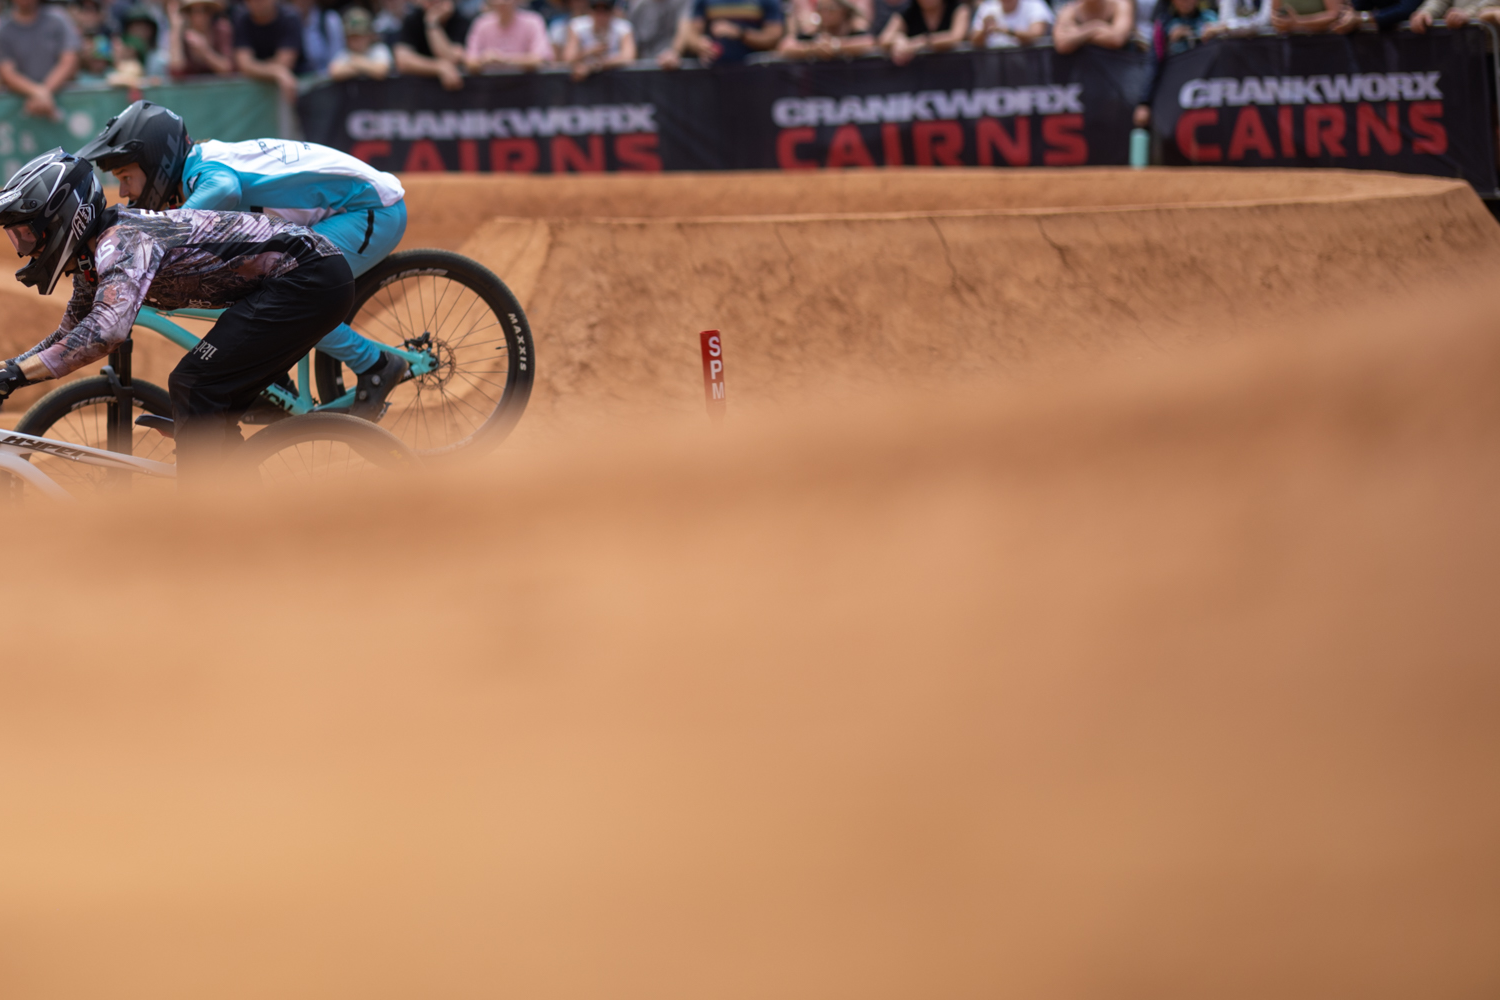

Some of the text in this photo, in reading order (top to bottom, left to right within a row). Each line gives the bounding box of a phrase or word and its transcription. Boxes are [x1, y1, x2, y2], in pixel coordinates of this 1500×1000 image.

[773, 83, 1083, 127] CRANKWORX
[1179, 71, 1443, 109] CRANKWORX
[347, 103, 658, 139] CRANKWORX
[777, 114, 1089, 172] CAIRNS
[1176, 102, 1448, 161] CAIRNS
[142, 133, 180, 211] BELL
[508, 313, 527, 371] MAXXIS
